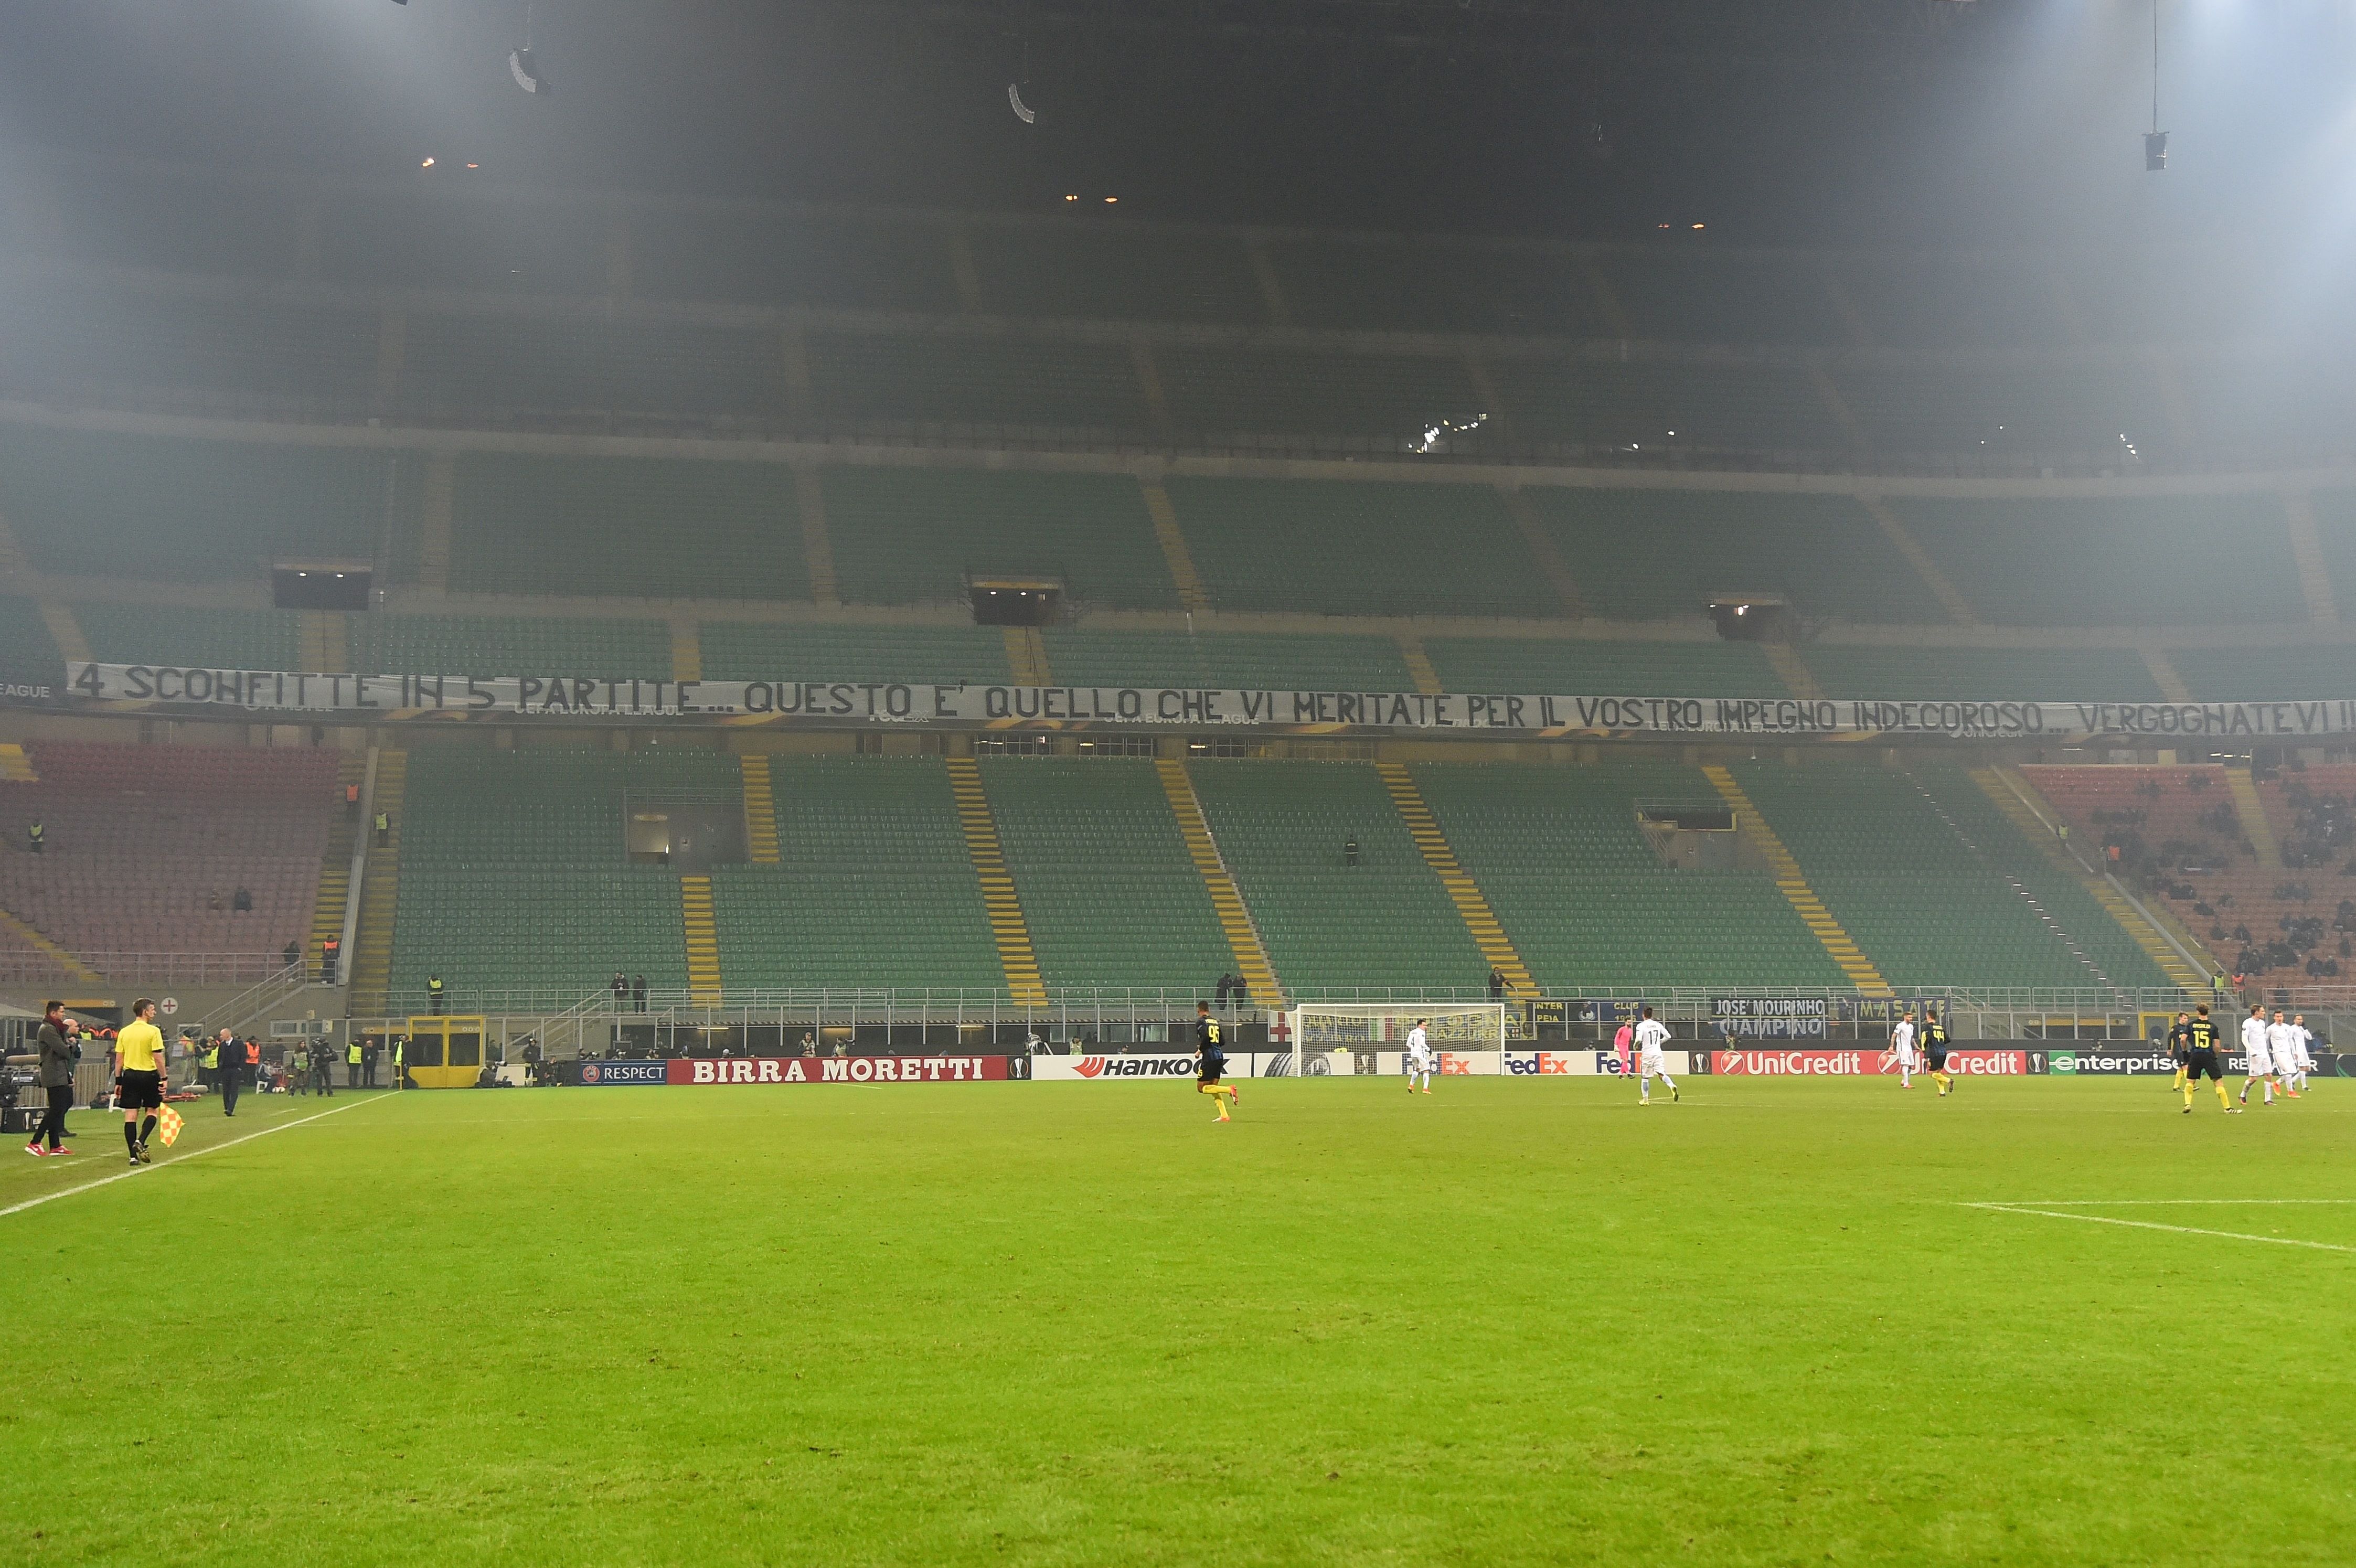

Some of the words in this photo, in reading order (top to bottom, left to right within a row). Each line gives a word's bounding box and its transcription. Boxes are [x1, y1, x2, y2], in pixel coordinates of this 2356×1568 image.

[76, 664, 104, 697] 4
[124, 666, 378, 707] SCONFITTE
[402, 675, 443, 708] IN
[468, 676, 495, 709] 5
[744, 682, 911, 717] QUESTO
[986, 687, 1141, 719] QUELLO
[1158, 690, 1222, 720] CHE
[1240, 691, 1273, 720] VI
[1294, 692, 1453, 726] MERITATE
[1467, 695, 1526, 727] PER
[1540, 696, 1566, 727] IL
[1576, 697, 1703, 728] VOSTRO
[1716, 700, 1837, 730] IMPEGNO
[1753, 999, 1824, 1015] MOURINHO
[1860, 999, 1945, 1017] MASATE
[1208, 1025, 1220, 1043] 95
[1720, 1018, 1822, 1035] CIAMPINO
[1411, 1037, 1415, 1048] 4
[1648, 1030, 1658, 1045] 17
[1933, 1030, 1945, 1042] 44
[2193, 1031, 2209, 1048] 15
[693, 1061, 806, 1082] BIRRA
[822, 1059, 983, 1081] MORETTI
[1402, 1053, 1469, 1074] FdEx
[1500, 1053, 1568, 1074] FedEx
[1596, 1052, 1642, 1074] FedE
[1747, 1052, 1861, 1074] UniCredit
[604, 1067, 665, 1079] RESPECT
